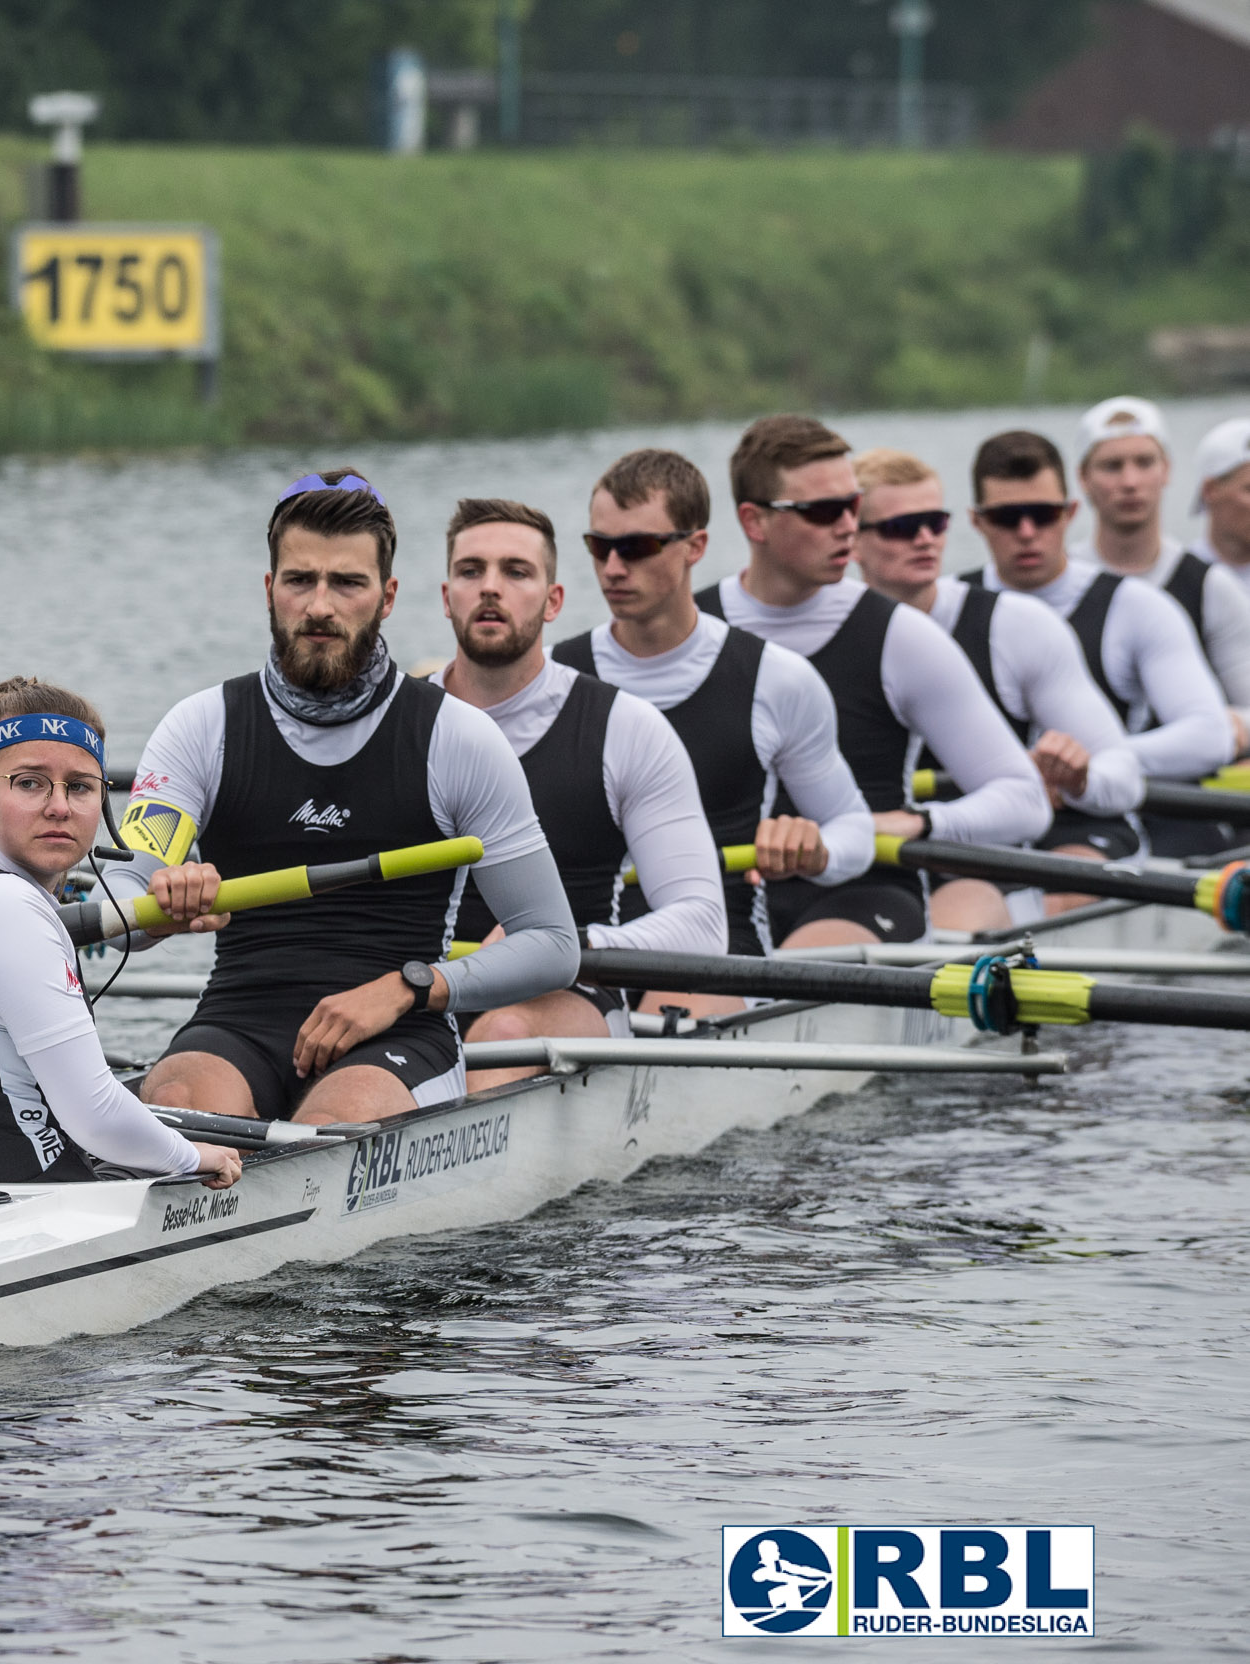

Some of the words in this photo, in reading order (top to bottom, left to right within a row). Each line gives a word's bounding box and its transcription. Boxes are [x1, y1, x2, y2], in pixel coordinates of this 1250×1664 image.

[23, 254, 190, 324] 1750
[41, 718, 69, 737] NK
[84, 727, 100, 754] NK
[365, 1130, 404, 1191] RBL
[403, 1113, 511, 1182] RUDER-BUNDESLIGA
[207, 1190, 239, 1221] Minden
